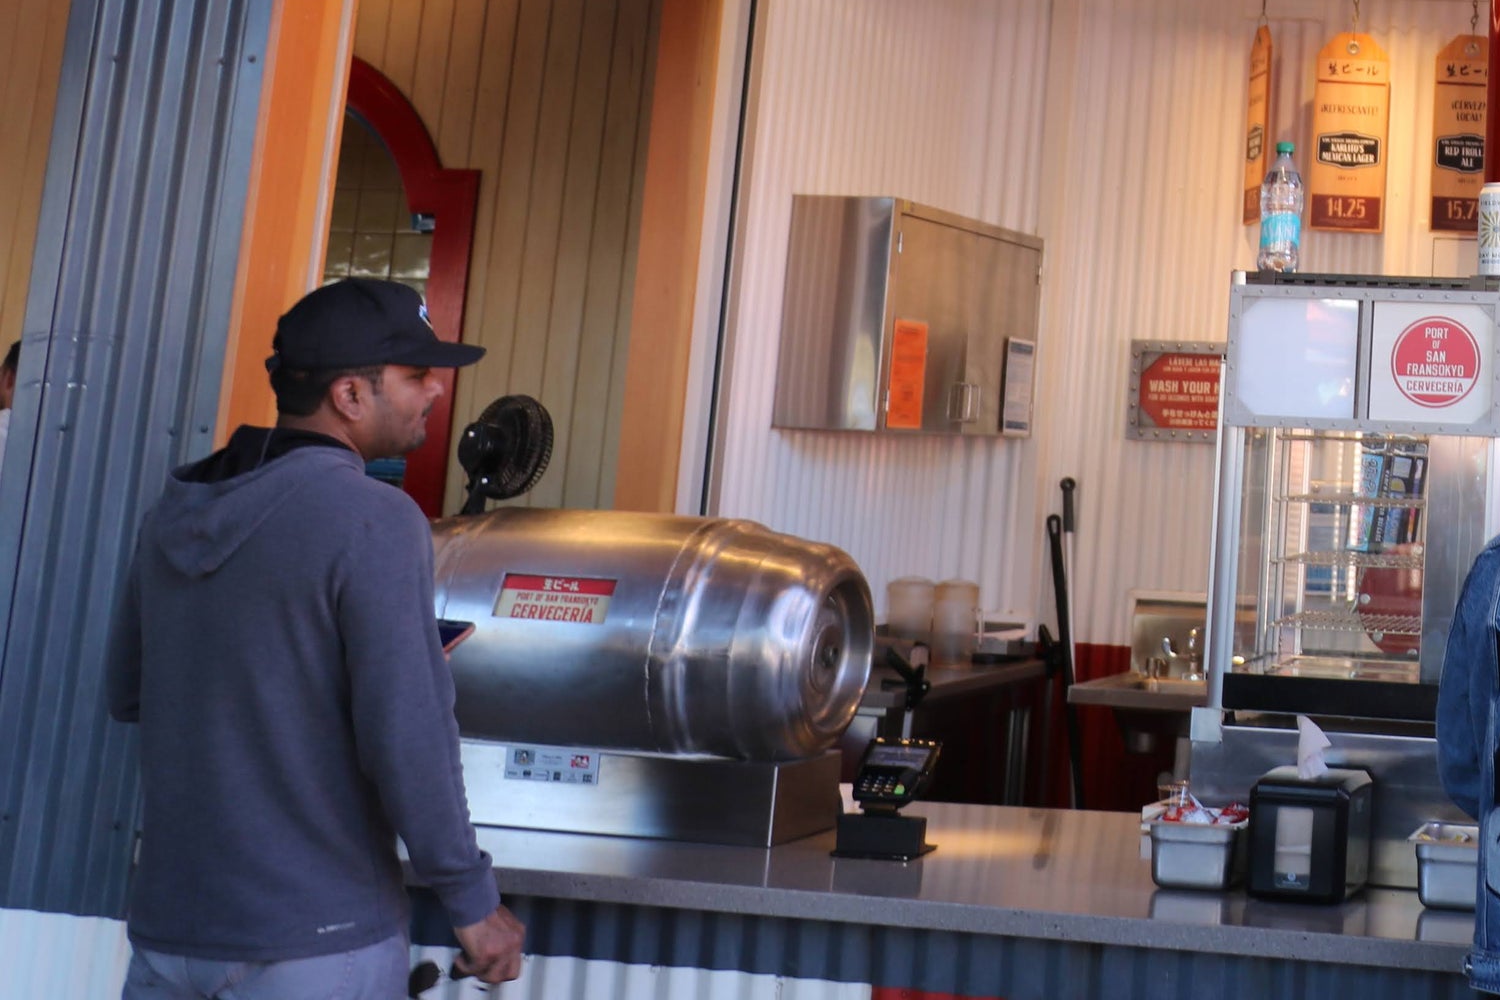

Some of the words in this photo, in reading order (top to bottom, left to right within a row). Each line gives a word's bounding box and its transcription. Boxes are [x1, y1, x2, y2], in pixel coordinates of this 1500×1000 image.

[1353, 152, 1375, 163] LAGER
[1327, 197, 1366, 219] 14.25
[1425, 327, 1449, 339] PORT
[1432, 340, 1441, 349] OF
[1426, 350, 1446, 363] SAN
[1407, 362, 1464, 377] FRANSOKYO
[1149, 380, 1179, 393] WASH
[1182, 381, 1211, 394] YOUR
[1406, 379, 1464, 393] CERVECERÍA
[543, 578, 579, 591] 生ビール
[516, 592, 534, 601] PORT
[545, 594, 559, 603] SAN
[510, 603, 593, 623] CERVECERÍA
